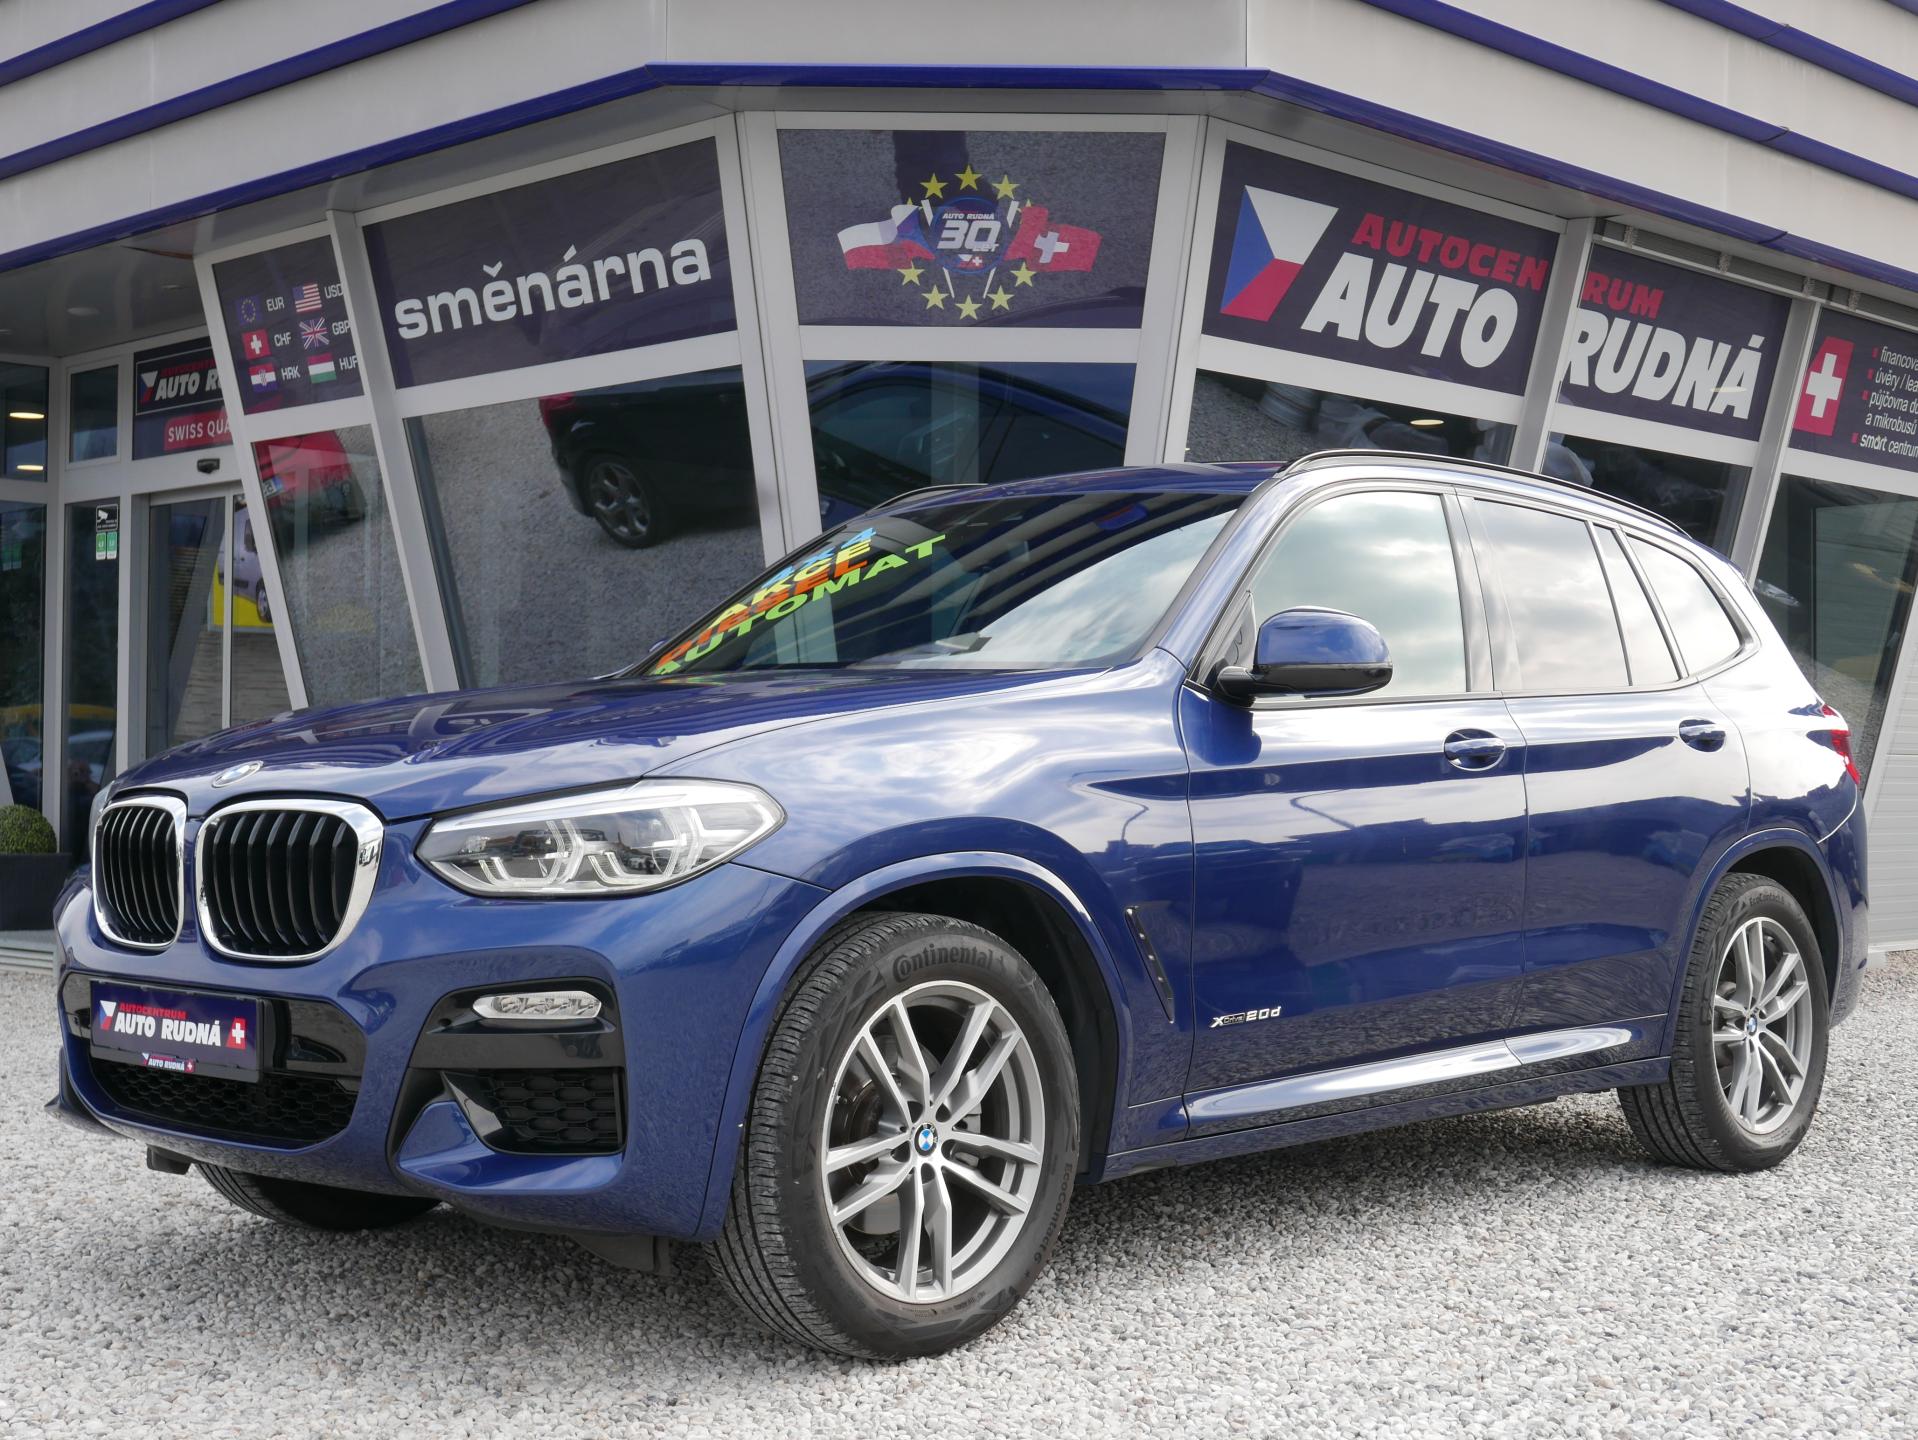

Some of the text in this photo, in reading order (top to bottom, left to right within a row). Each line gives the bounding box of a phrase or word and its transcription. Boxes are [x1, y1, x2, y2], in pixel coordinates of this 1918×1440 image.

[936, 220, 1002, 250] 30
[324, 283, 344, 299] USD
[394, 238, 712, 340] směnárna
[266, 296, 285, 312] EUR
[1300, 252, 1518, 368] AUTO
[274, 332, 292, 347] CHF
[332, 320, 351, 336] GBP
[281, 365, 301, 380] HRK
[339, 355, 358, 371] HUF
[1566, 308, 1765, 420] RUDNÁ
[154, 372, 201, 401] AUTO
[1875, 367, 1901, 391] úvěry
[1869, 389, 1908, 412] půjčovna
[168, 422, 204, 442] SWISS
[1865, 412, 1918, 435] a mikrobusů
[655, 534, 945, 675] AUTOMAT
[892, 943, 994, 982] Continental
[119, 1002, 187, 1020] AUTOCENTRUM
[114, 1011, 221, 1047] AUTO RUDNÁ
[149, 1058, 185, 1071] AUTO RUDNÁ
[1040, 1163, 1073, 1252] EcoContact
